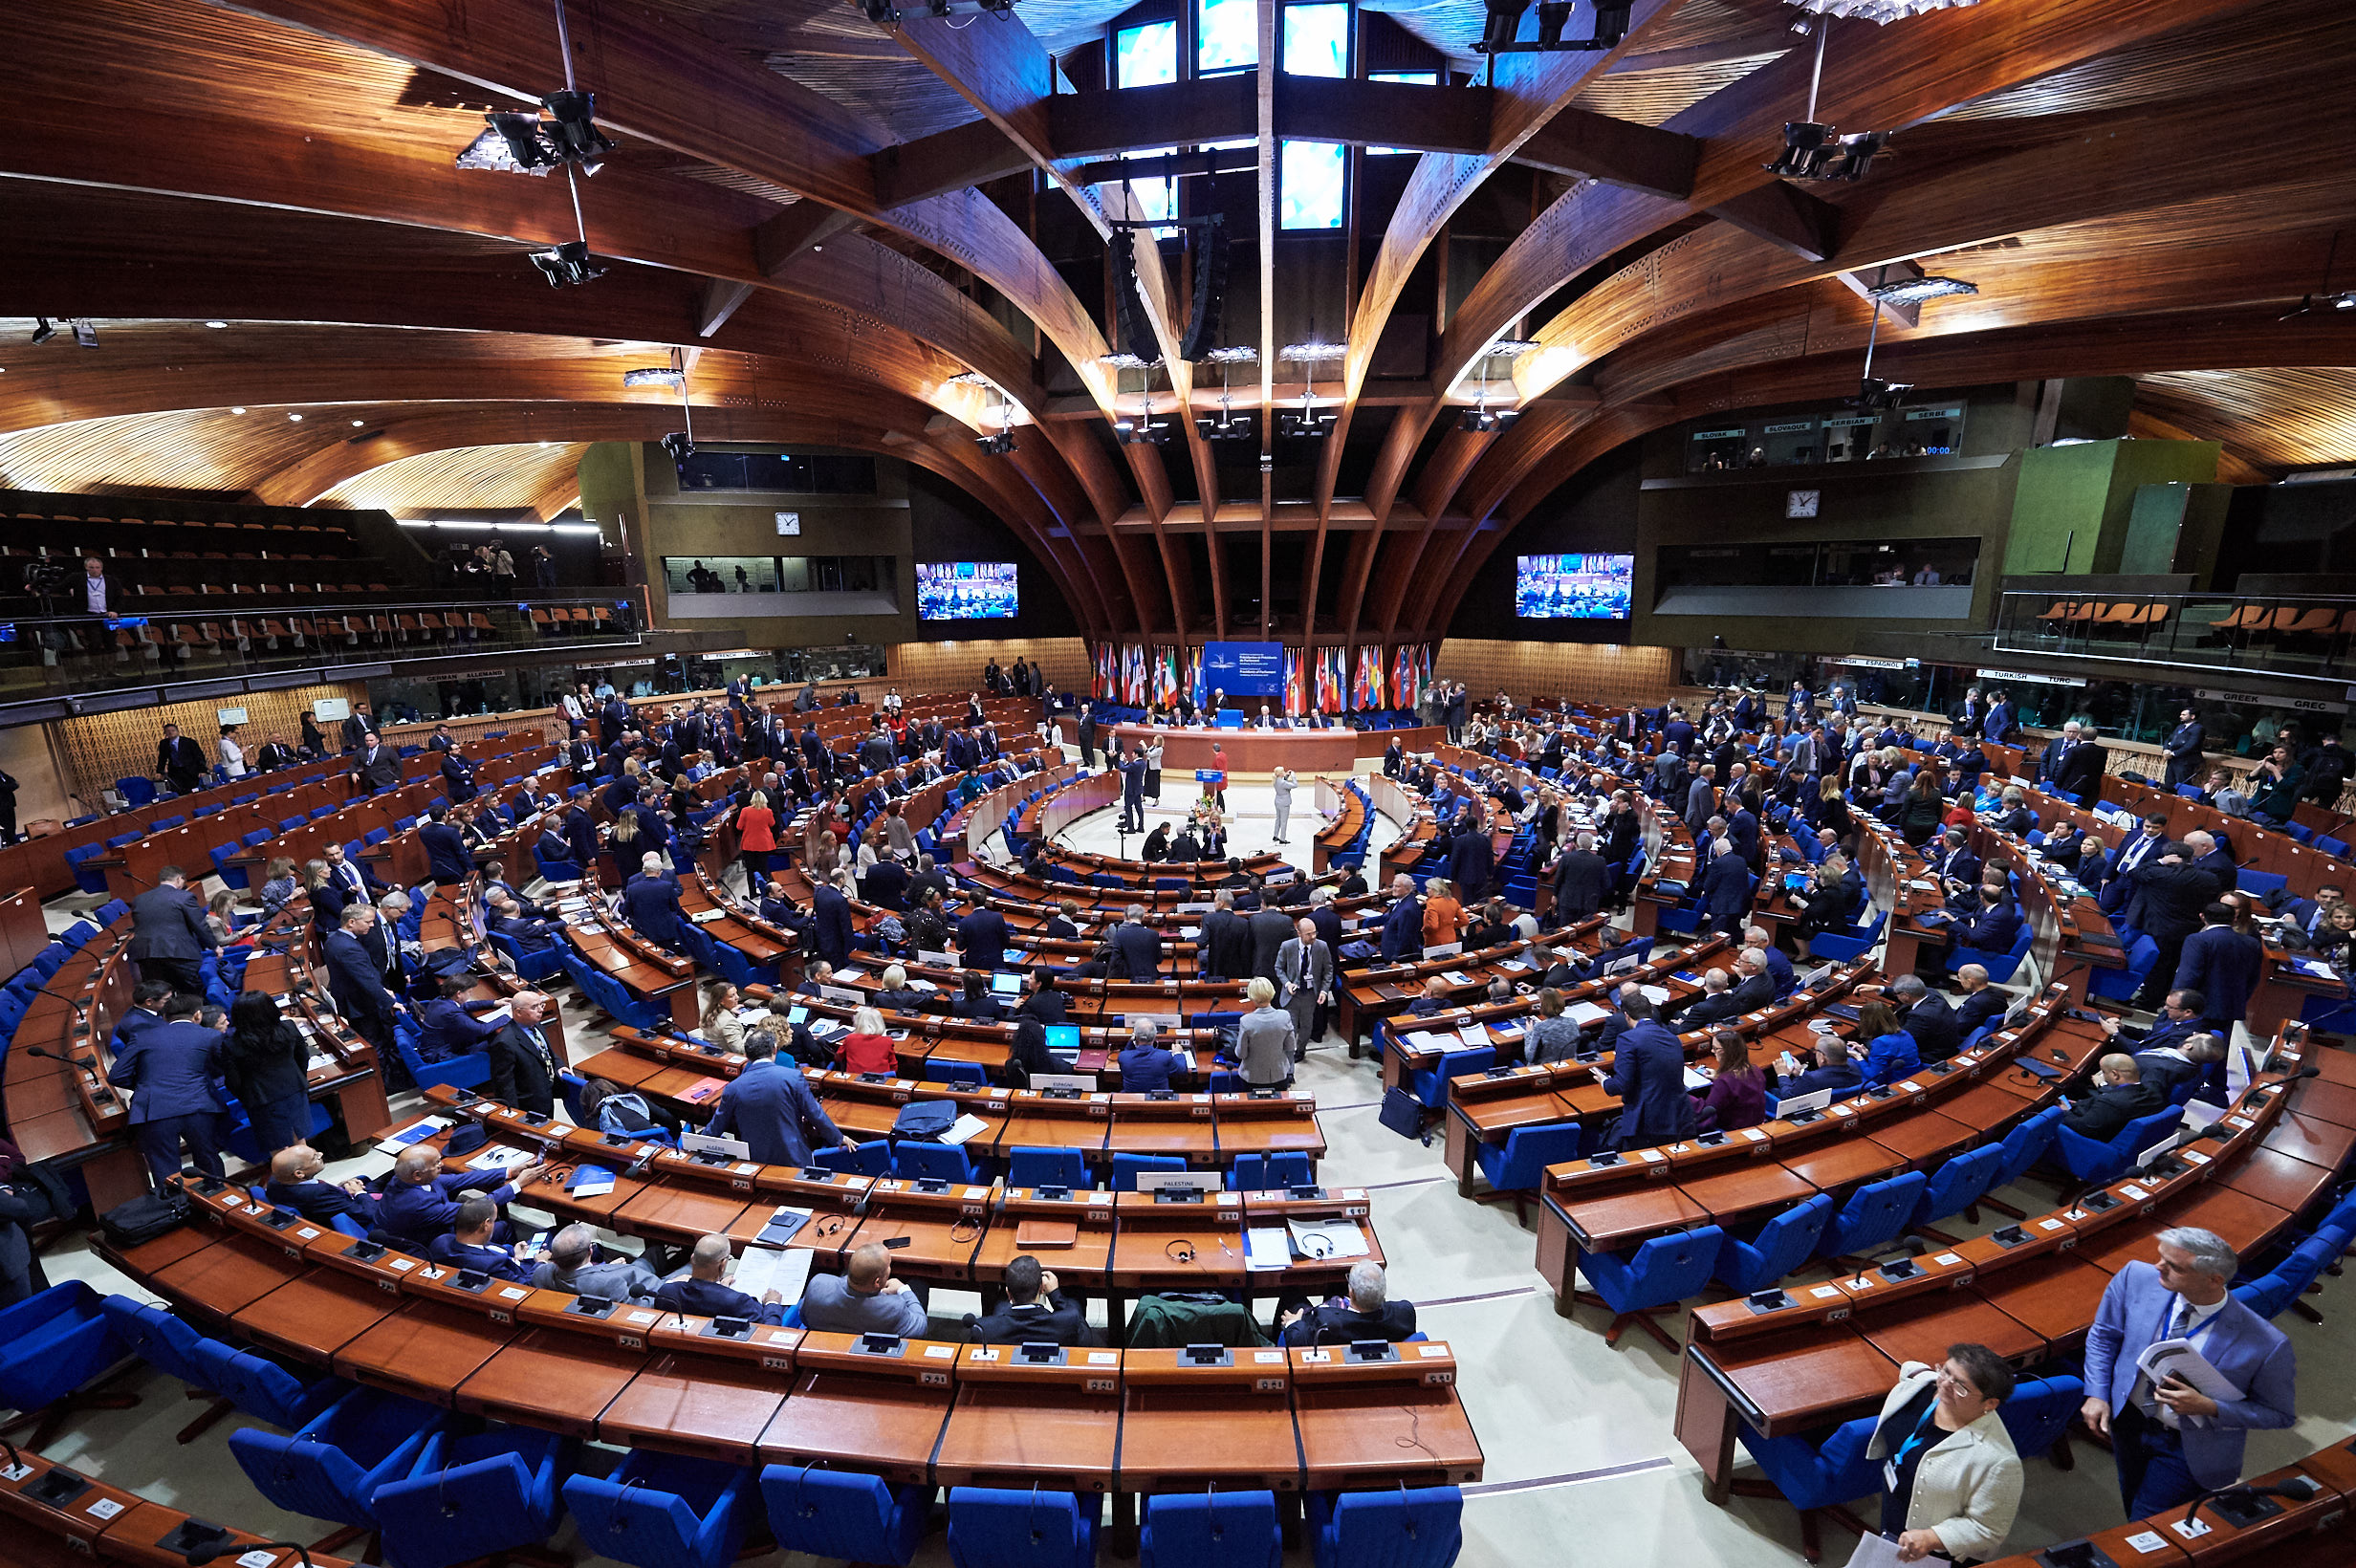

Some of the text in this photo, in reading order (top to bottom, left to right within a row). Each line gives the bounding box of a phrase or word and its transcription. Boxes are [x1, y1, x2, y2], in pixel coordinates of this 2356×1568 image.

[1918, 410, 1947, 419] SERBE
[1830, 418, 1866, 426] SERBIAN
[1769, 424, 1806, 432] SLOVAQUE
[1927, 446, 1951, 455] 00:00
[1865, 660, 1899, 668] ESPAGNOL
[426, 673, 458, 682] GERMAN
[1995, 671, 2027, 680] TURKISH
[2198, 689, 2326, 710] 8 GREEK GREC
